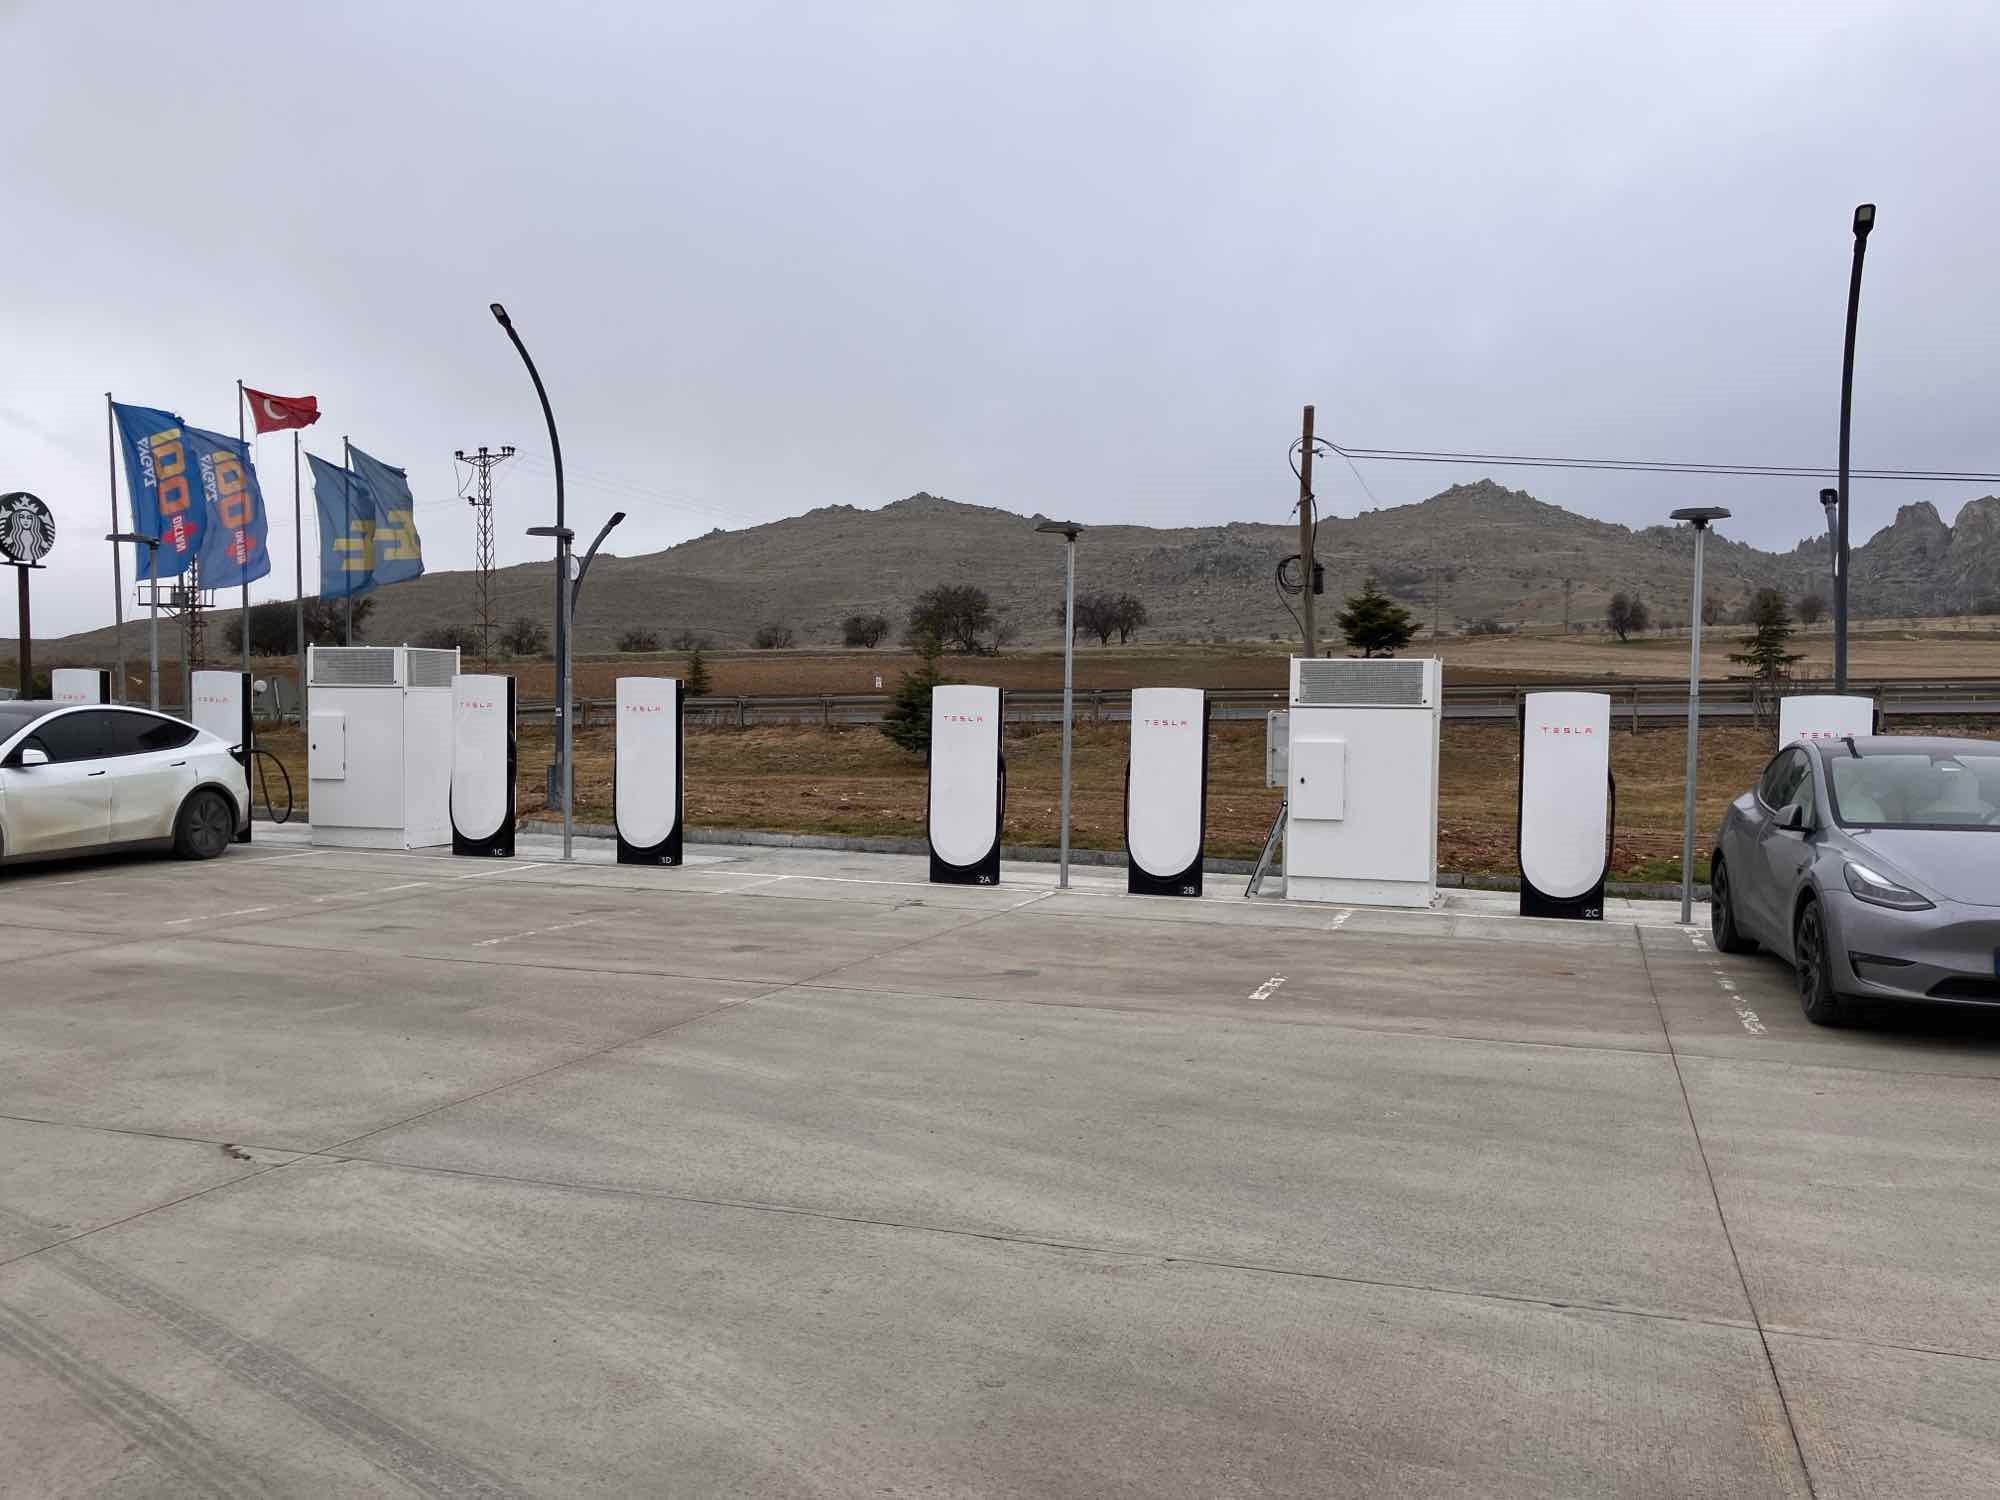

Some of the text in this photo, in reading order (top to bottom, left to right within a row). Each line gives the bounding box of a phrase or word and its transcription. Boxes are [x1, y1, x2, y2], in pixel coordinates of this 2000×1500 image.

[1541, 727, 1592, 735] TESLA
[493, 848, 503, 856] 1C
[979, 875, 991, 884] 2A
[1183, 886, 1195, 895] 2B
[1584, 908, 1600, 918] 2C
